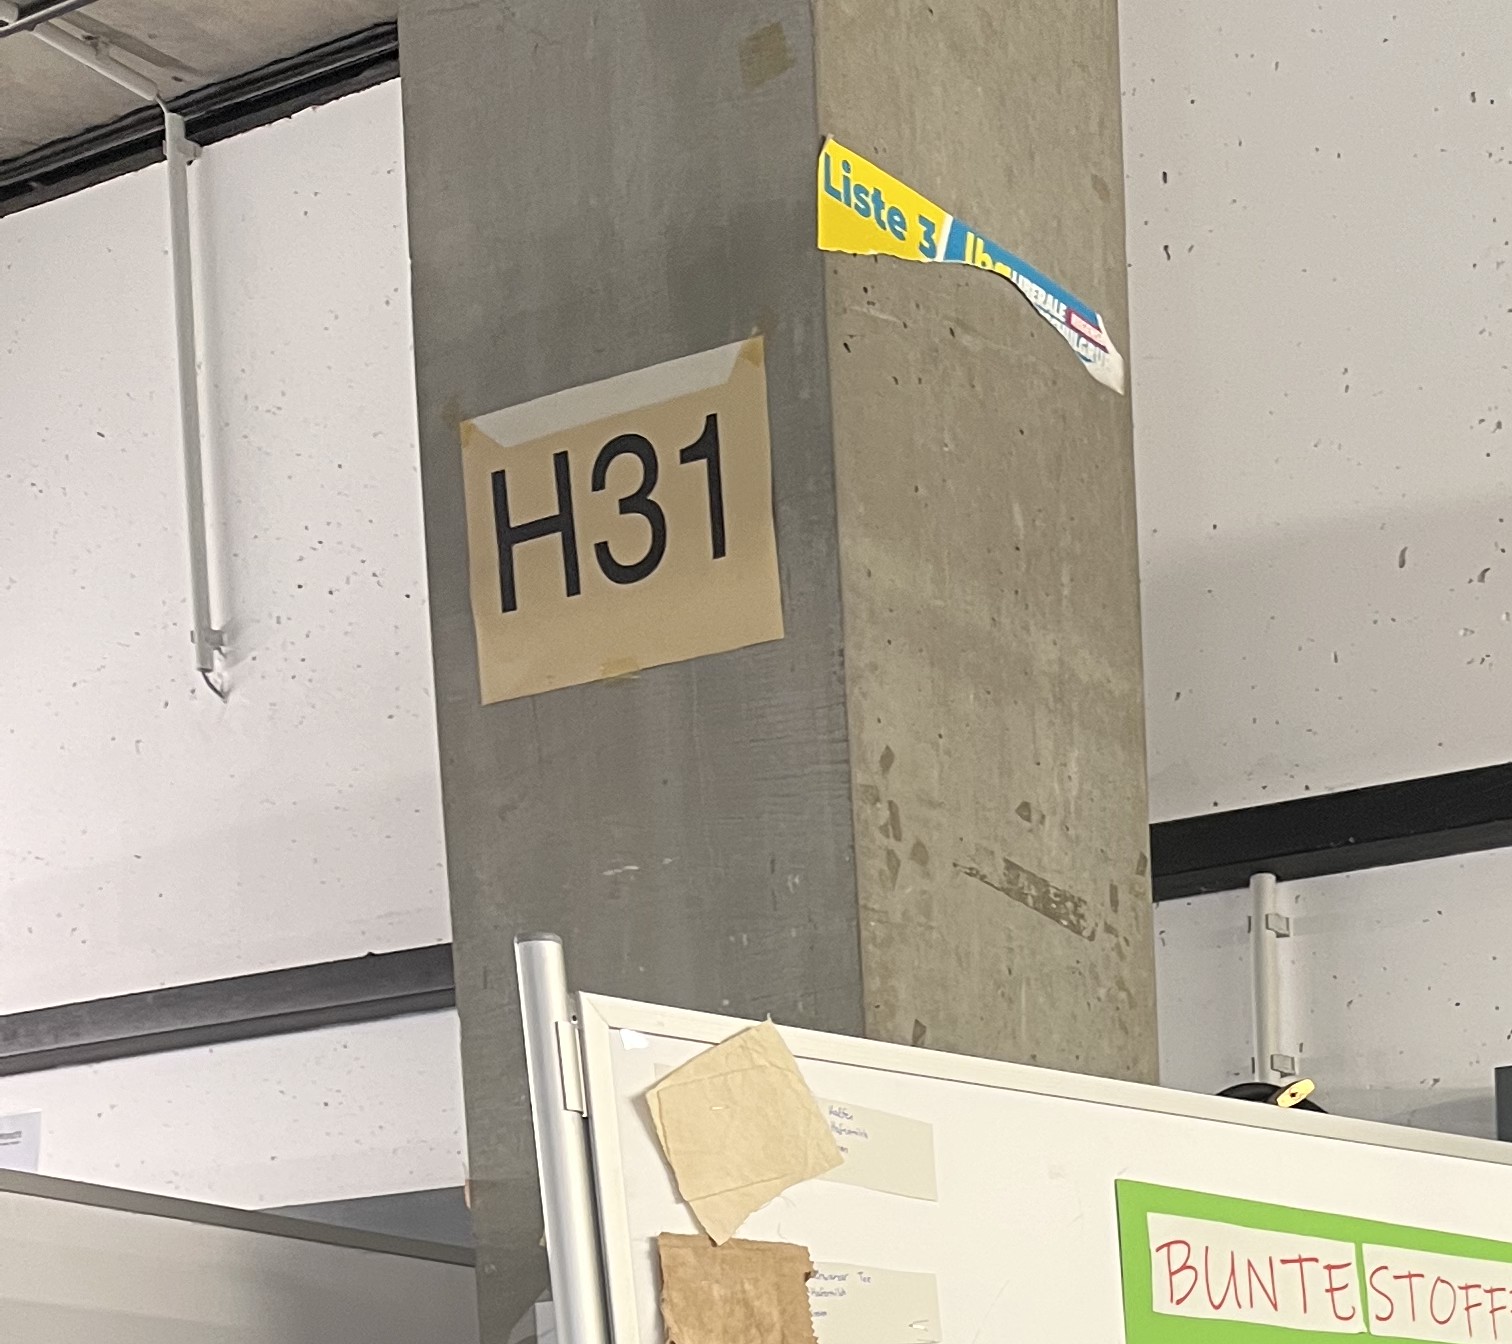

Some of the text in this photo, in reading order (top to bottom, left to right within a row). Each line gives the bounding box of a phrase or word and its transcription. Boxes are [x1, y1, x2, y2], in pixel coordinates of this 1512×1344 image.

[823, 152, 938, 261] Liste 3
[490, 412, 727, 615] H31
[1155, 1239, 1357, 1322] BUNTE
